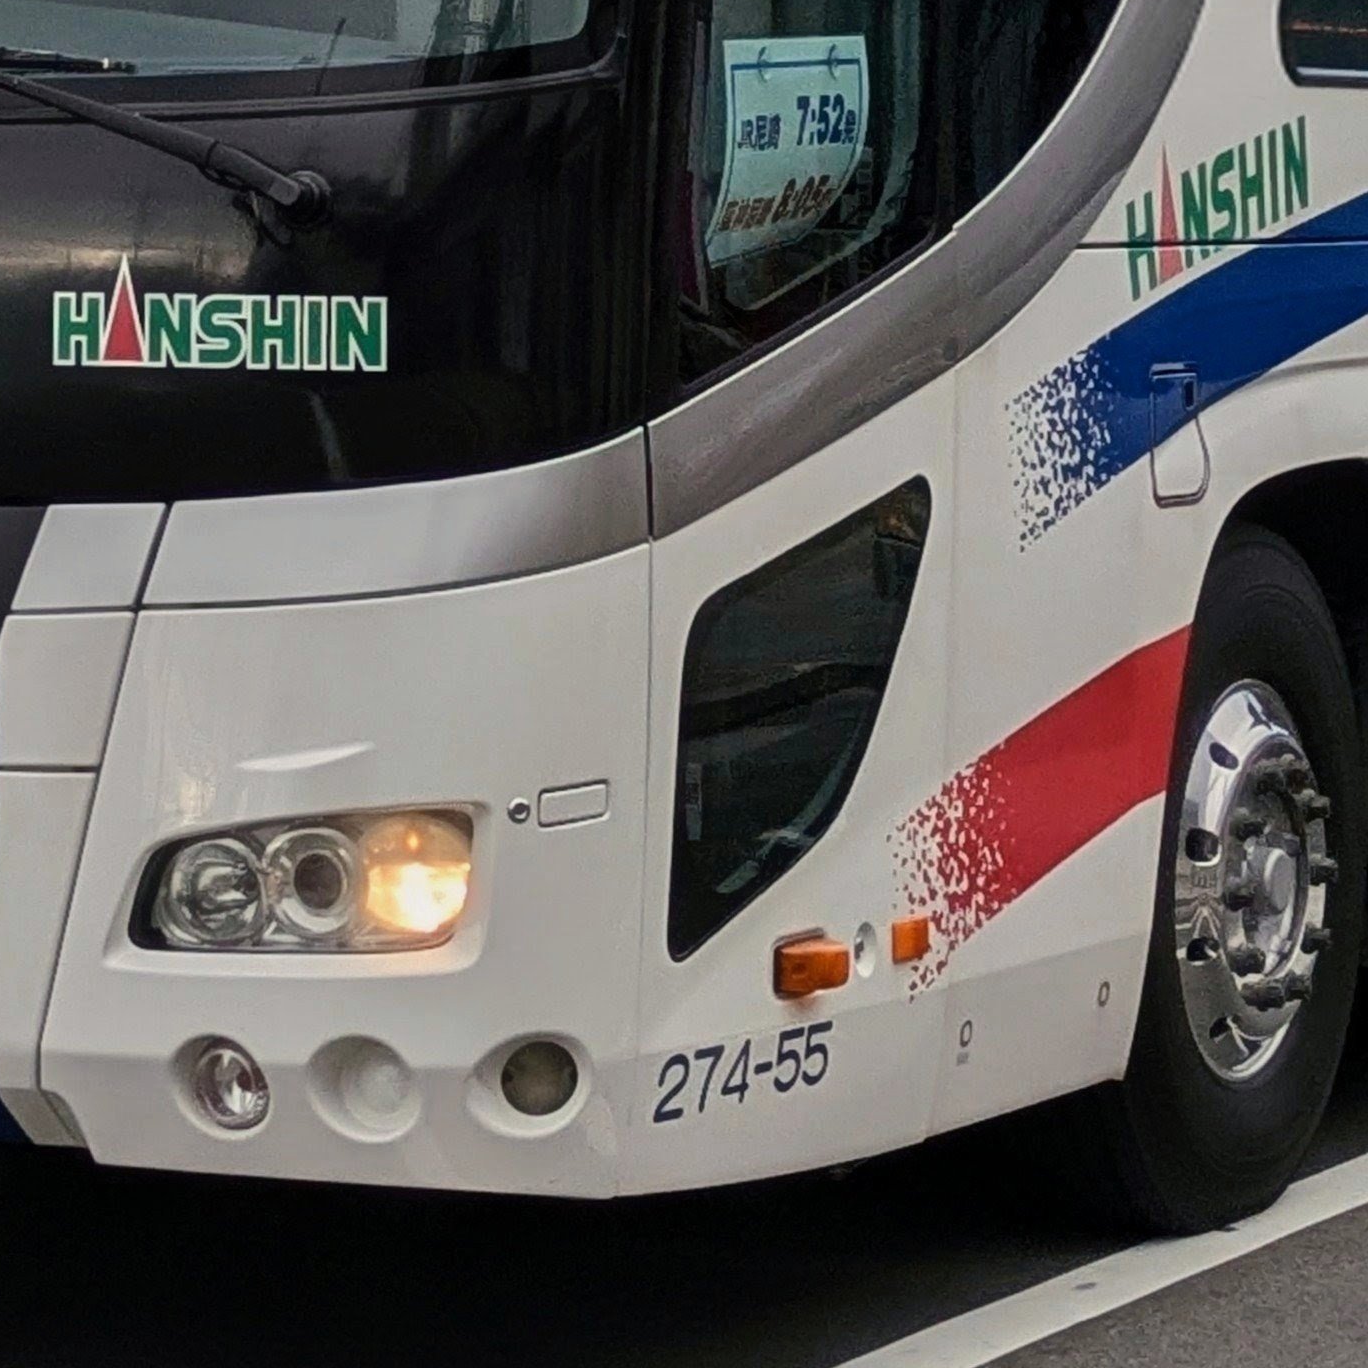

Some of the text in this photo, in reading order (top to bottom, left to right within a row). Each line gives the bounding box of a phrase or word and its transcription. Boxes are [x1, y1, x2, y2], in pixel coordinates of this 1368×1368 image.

[1125, 114, 1309, 302] HANSHIN
[53, 252, 388, 372] HANSHIN
[653, 1020, 833, 1123] 274-55
